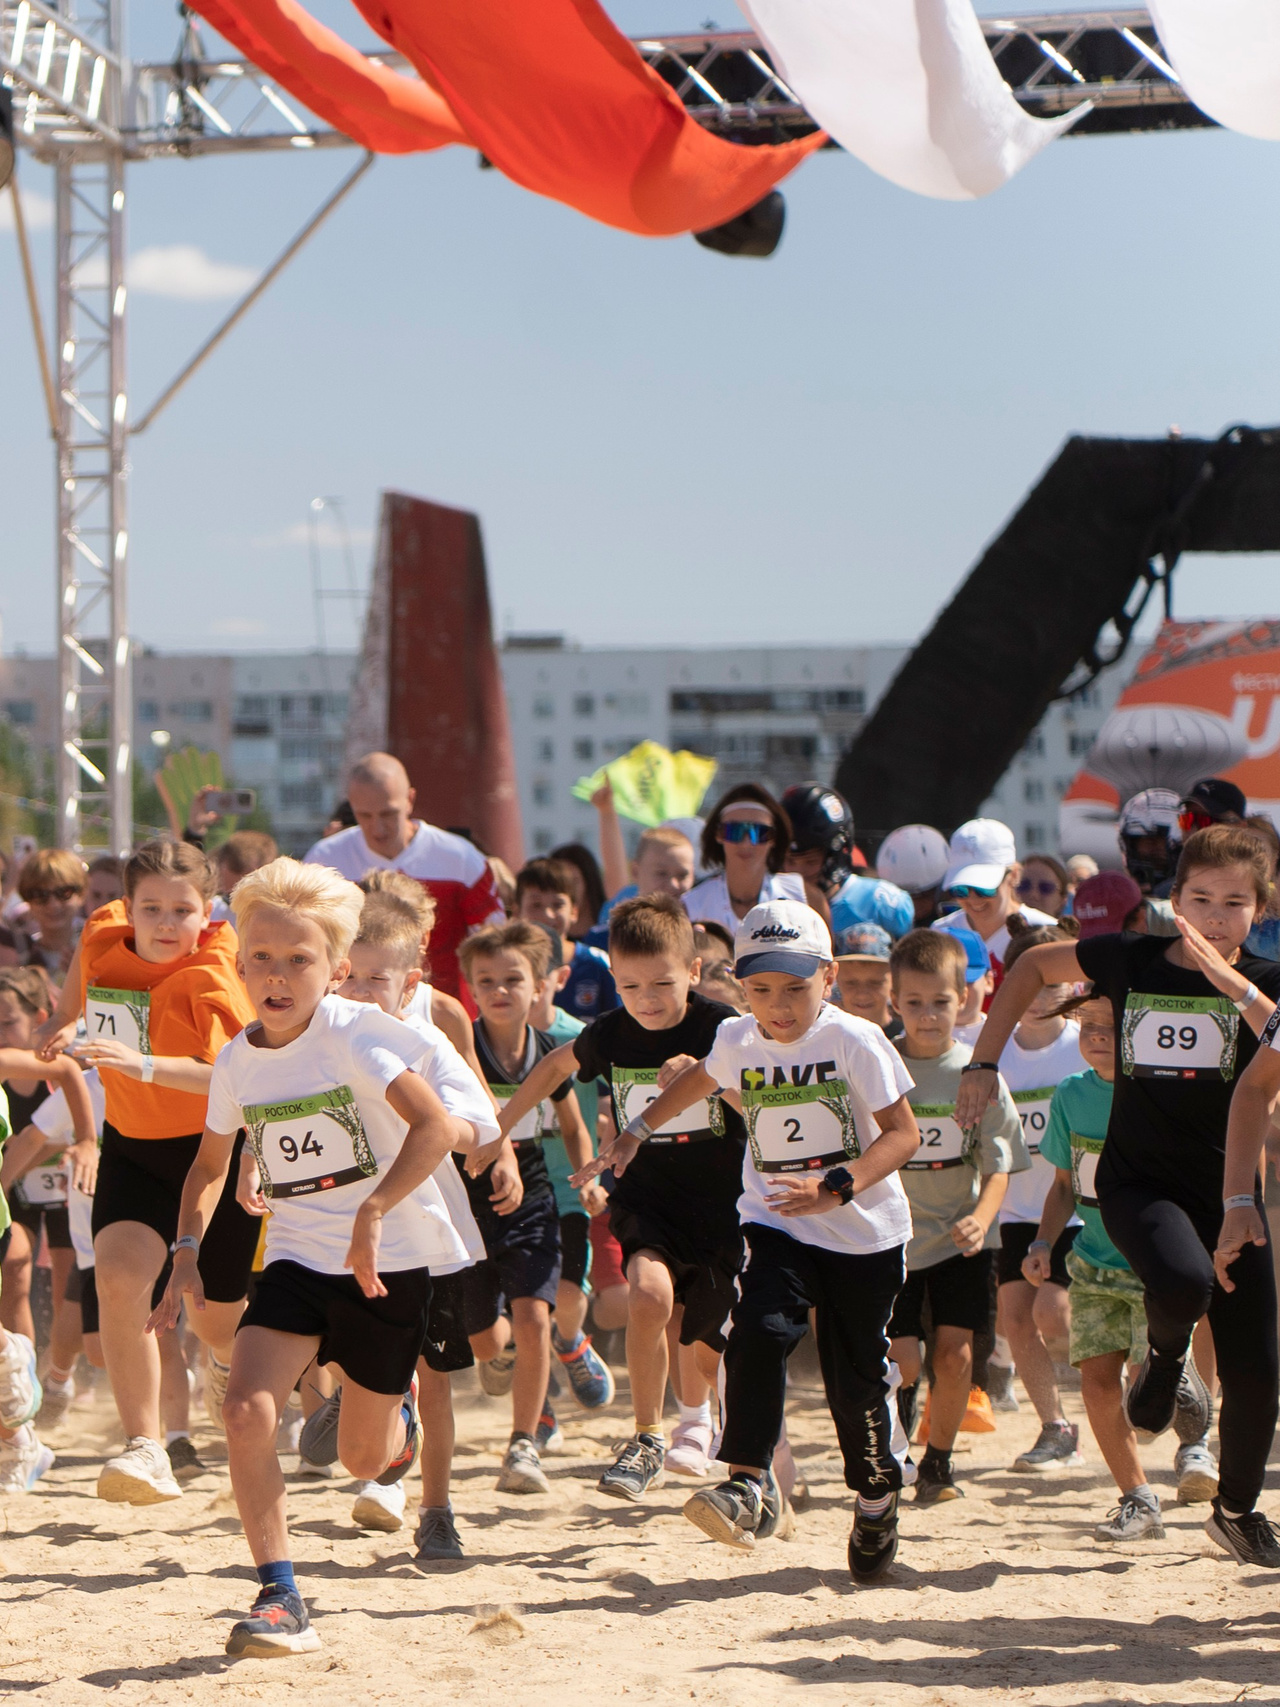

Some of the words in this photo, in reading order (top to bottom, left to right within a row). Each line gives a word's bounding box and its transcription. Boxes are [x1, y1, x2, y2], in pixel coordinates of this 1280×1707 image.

[1152, 998, 1196, 1010] РОСТОК
[95, 1012, 116, 1036] 71
[1157, 1025, 1198, 1050] 89
[634, 1072, 658, 1081] РОСТ
[761, 1090, 803, 1103] РОСТОК
[264, 1102, 305, 1118] РОСТОК
[1020, 1111, 1046, 1130] 70
[783, 1118, 805, 1143] 2
[278, 1130, 324, 1163] 94
